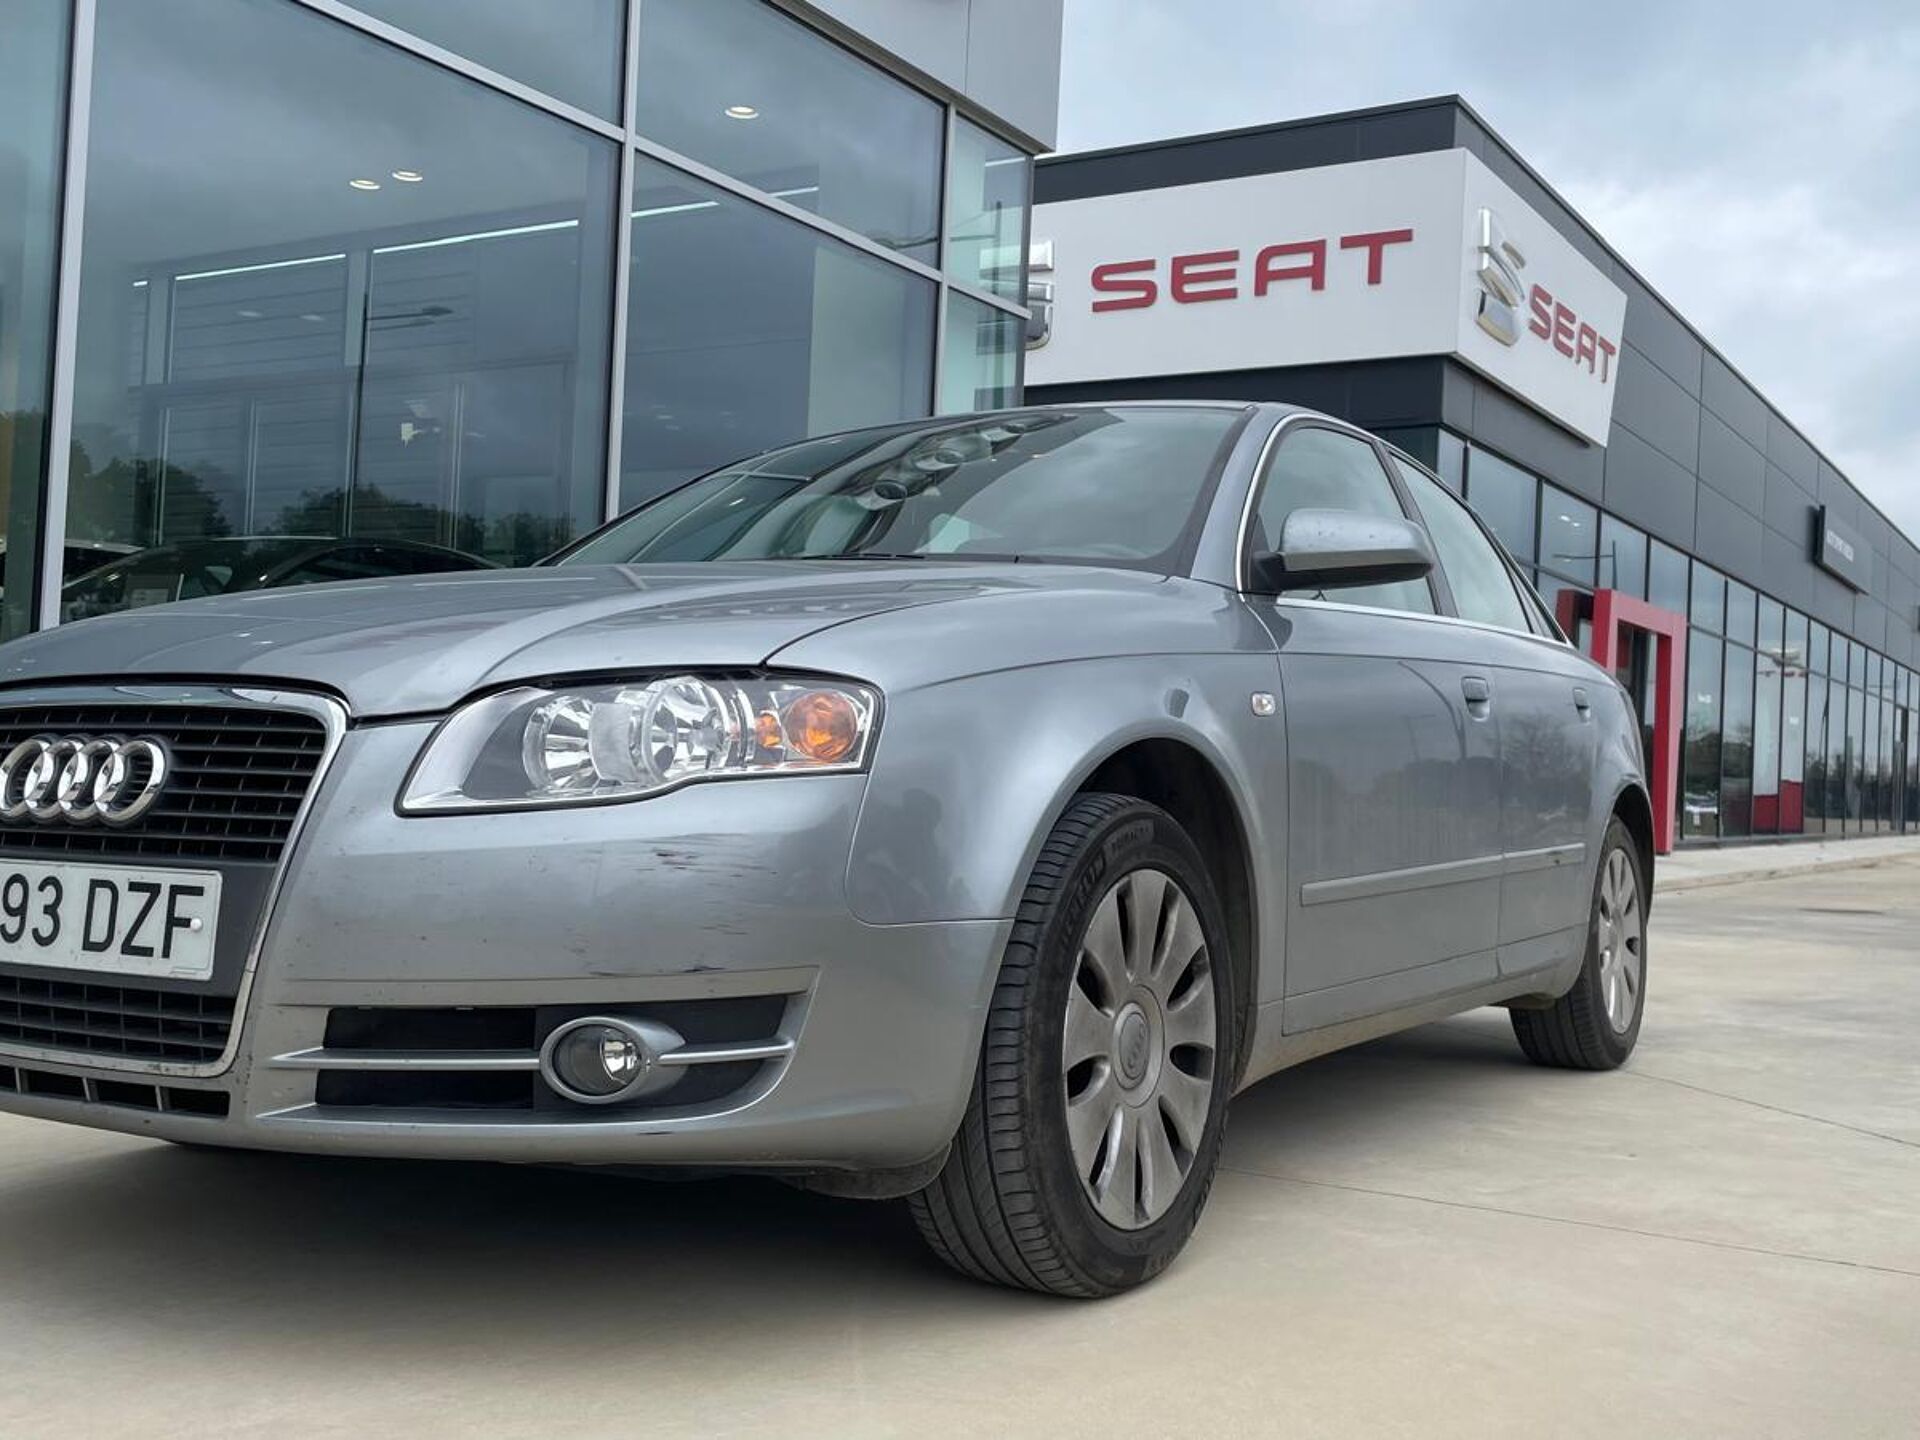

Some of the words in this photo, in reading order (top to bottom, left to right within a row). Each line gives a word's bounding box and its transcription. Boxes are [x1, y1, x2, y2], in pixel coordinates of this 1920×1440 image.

[1091, 228, 1413, 312] SEAT
[1528, 283, 1616, 384] SEAT
[0, 873, 63, 947] 93
[82, 878, 205, 958] DZF
